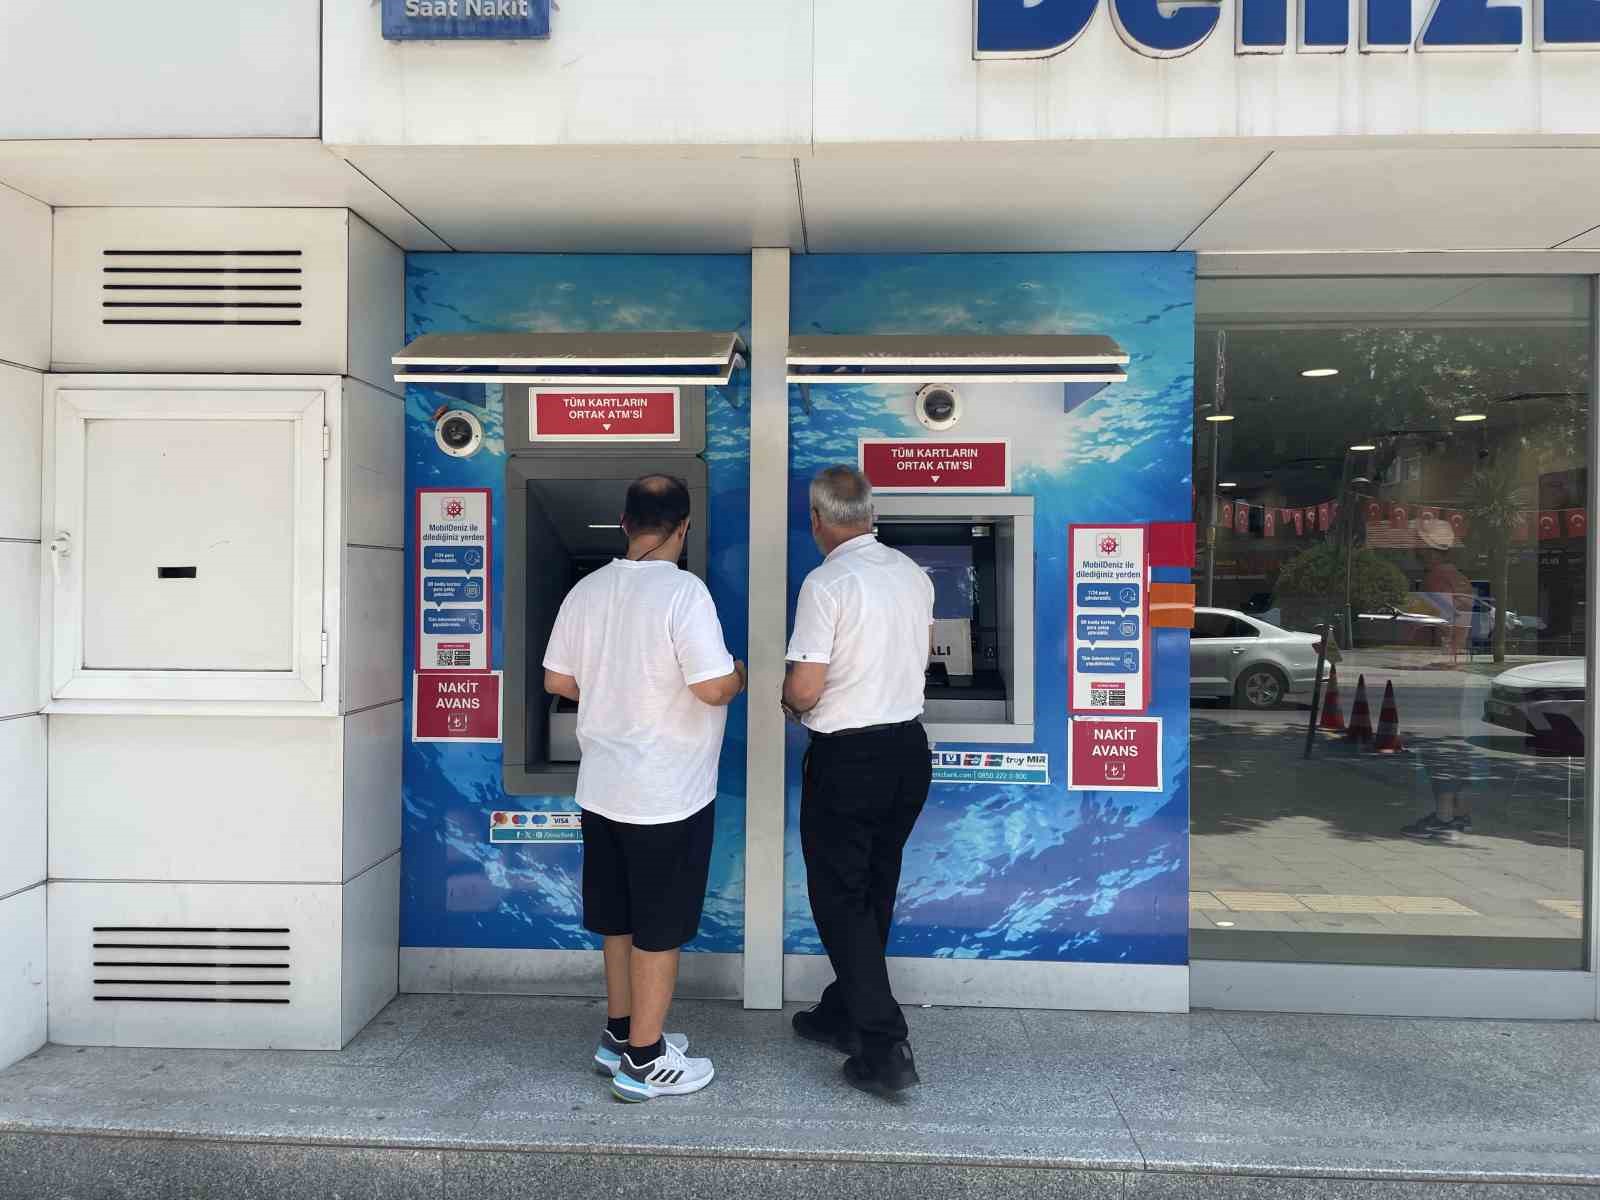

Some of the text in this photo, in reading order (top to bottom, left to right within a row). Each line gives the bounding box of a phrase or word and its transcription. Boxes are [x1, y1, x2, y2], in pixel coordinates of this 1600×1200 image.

[563, 397, 648, 408] TÜM KARTLARIN
[568, 409, 605, 420] ORTAK
[891, 447, 979, 458] TÜM KARTLARIN
[896, 460, 934, 470] ORTAK
[429, 524, 478, 532] MobilDeniz ile
[1082, 560, 1135, 569] MobilDeniz ile
[1076, 569, 1141, 579] dilediğiniz yerden
[438, 680, 479, 693] NAKİT
[435, 698, 480, 709] AVANS
[1093, 727, 1137, 740] NAKİT
[1091, 745, 1139, 757] AVANS
